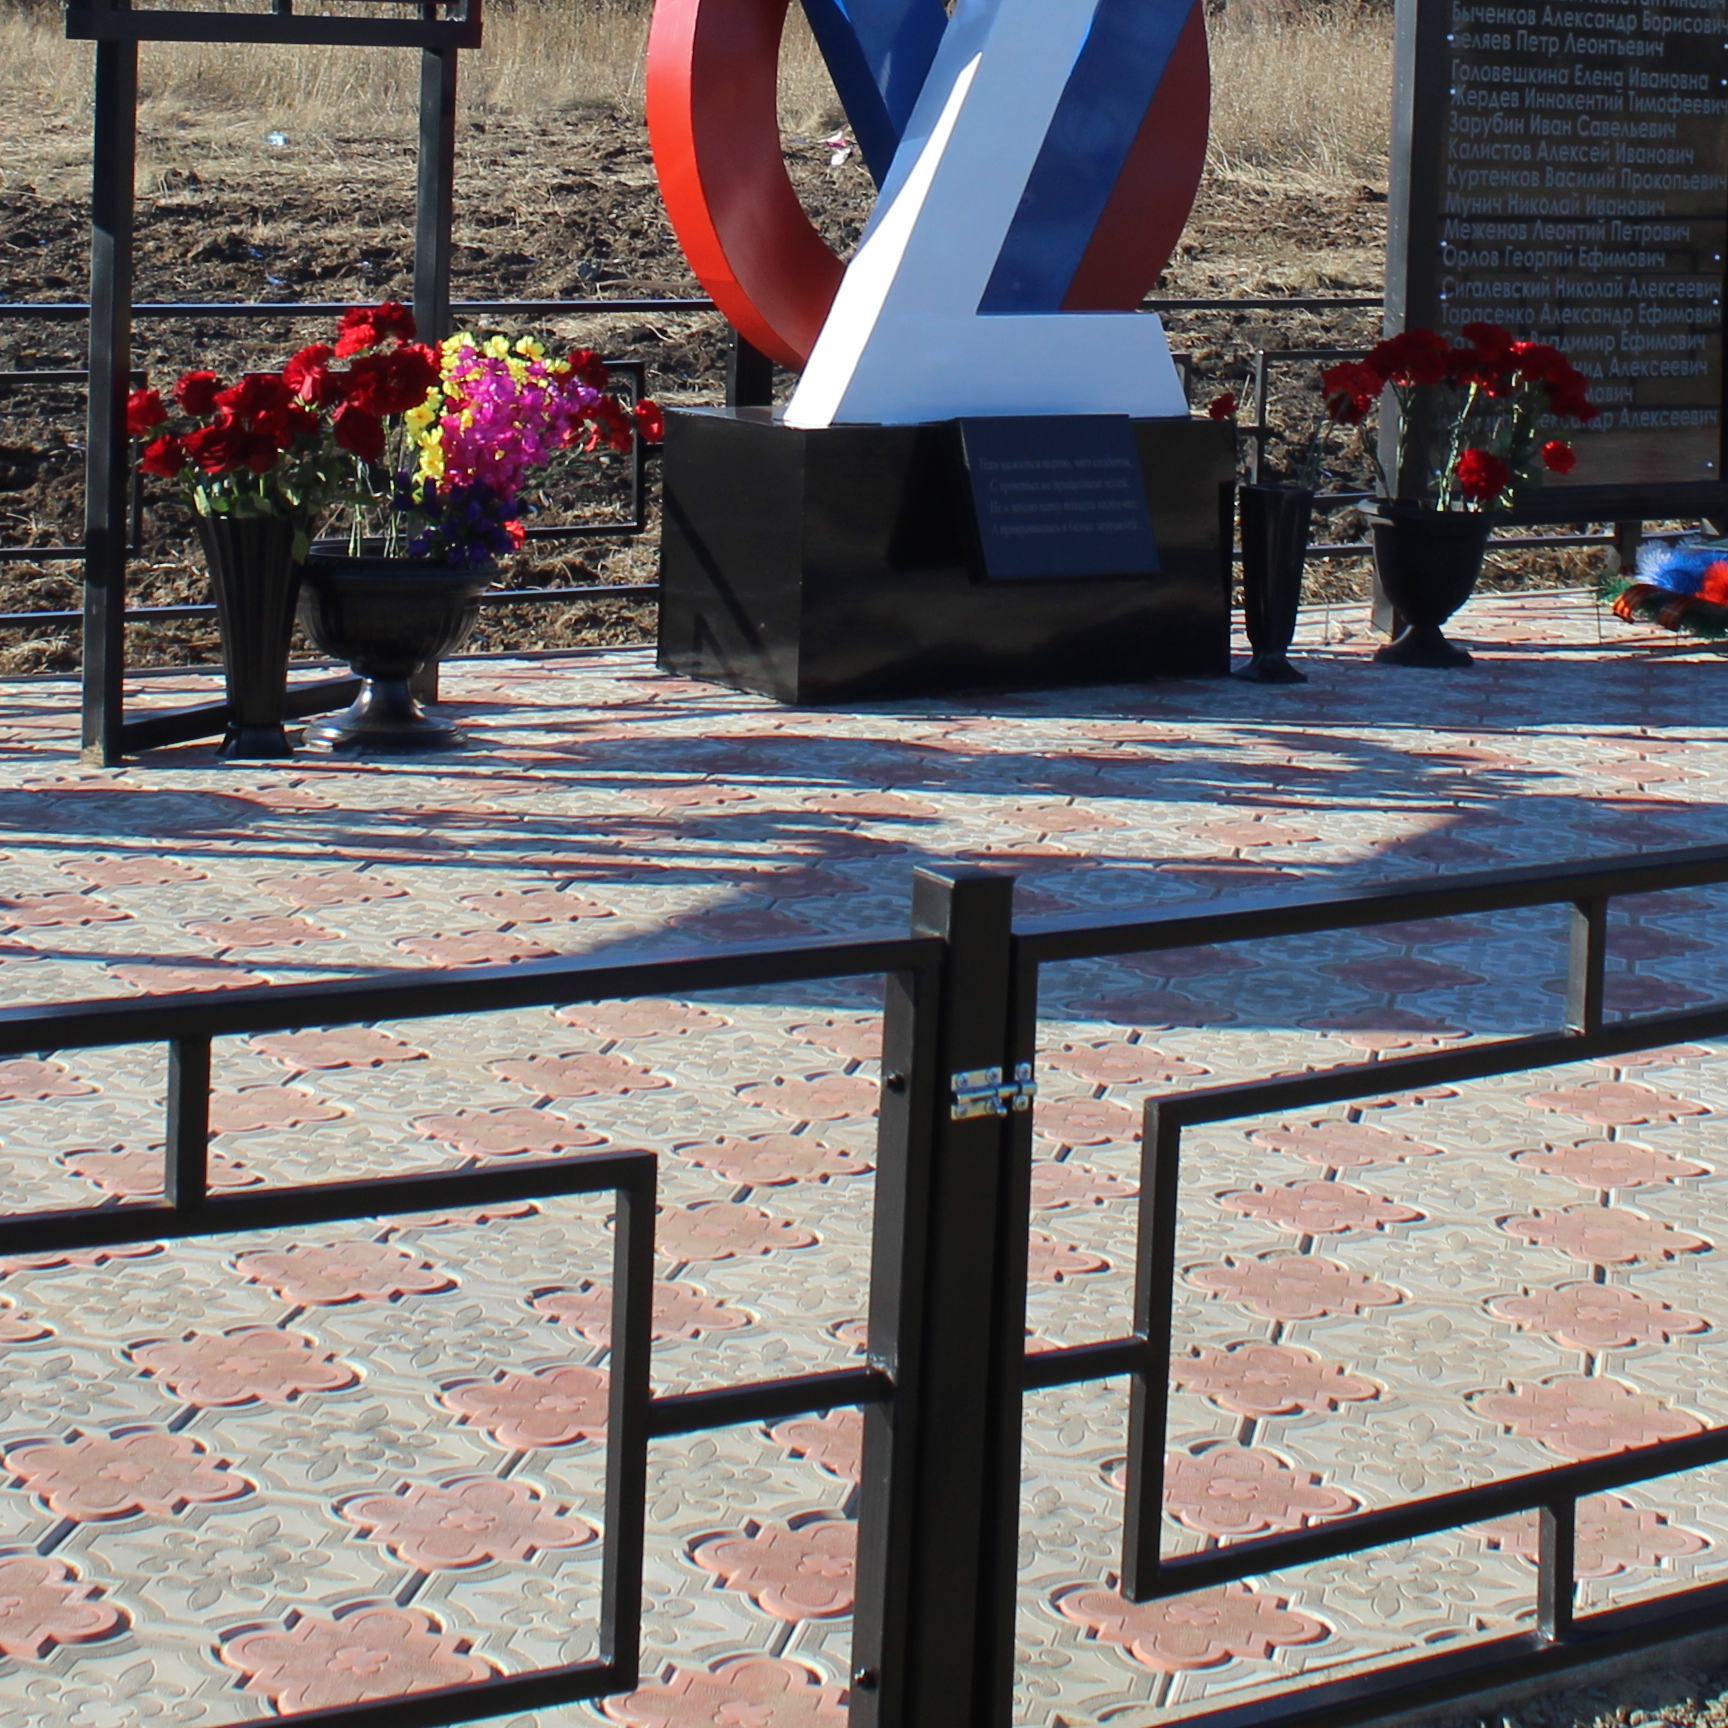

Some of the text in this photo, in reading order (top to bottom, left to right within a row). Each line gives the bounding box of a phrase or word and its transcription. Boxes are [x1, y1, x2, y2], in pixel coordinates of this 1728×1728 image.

[1451, 0, 1537, 26] Быченков
[1541, 4, 1638, 35] Александр
[1516, 29, 1559, 58] Петр
[1564, 32, 1665, 57] Леонтьевич
[1451, 58, 1710, 91] Головешкина Елена Ивановна
[1450, 84, 1520, 112] Жердев
[1524, 87, 1624, 113] Иннокентий
[1449, 110, 1677, 139] Зарубин Иван Савельевич
[1447, 137, 1694, 165] Калистов Алексей Иванович
[1446, 163, 1728, 194] Куртенков Василий Прокопьевич
[1444, 191, 1666, 218] Мунич Николай Иванович
[1443, 218, 1691, 247] Меженов Леонтий Петрович
[1442, 244, 1666, 272] Орлов Георгий Ефимович
[1441, 275, 1721, 299] Сигалевский Николай Алексеевич
[1441, 302, 1721, 328] Тарасенко Александр Ефимович
[1621, 330, 1706, 356] Ефимович
[1609, 356, 1708, 377] Алексеевич
[1619, 407, 1719, 428] Алексеевич
